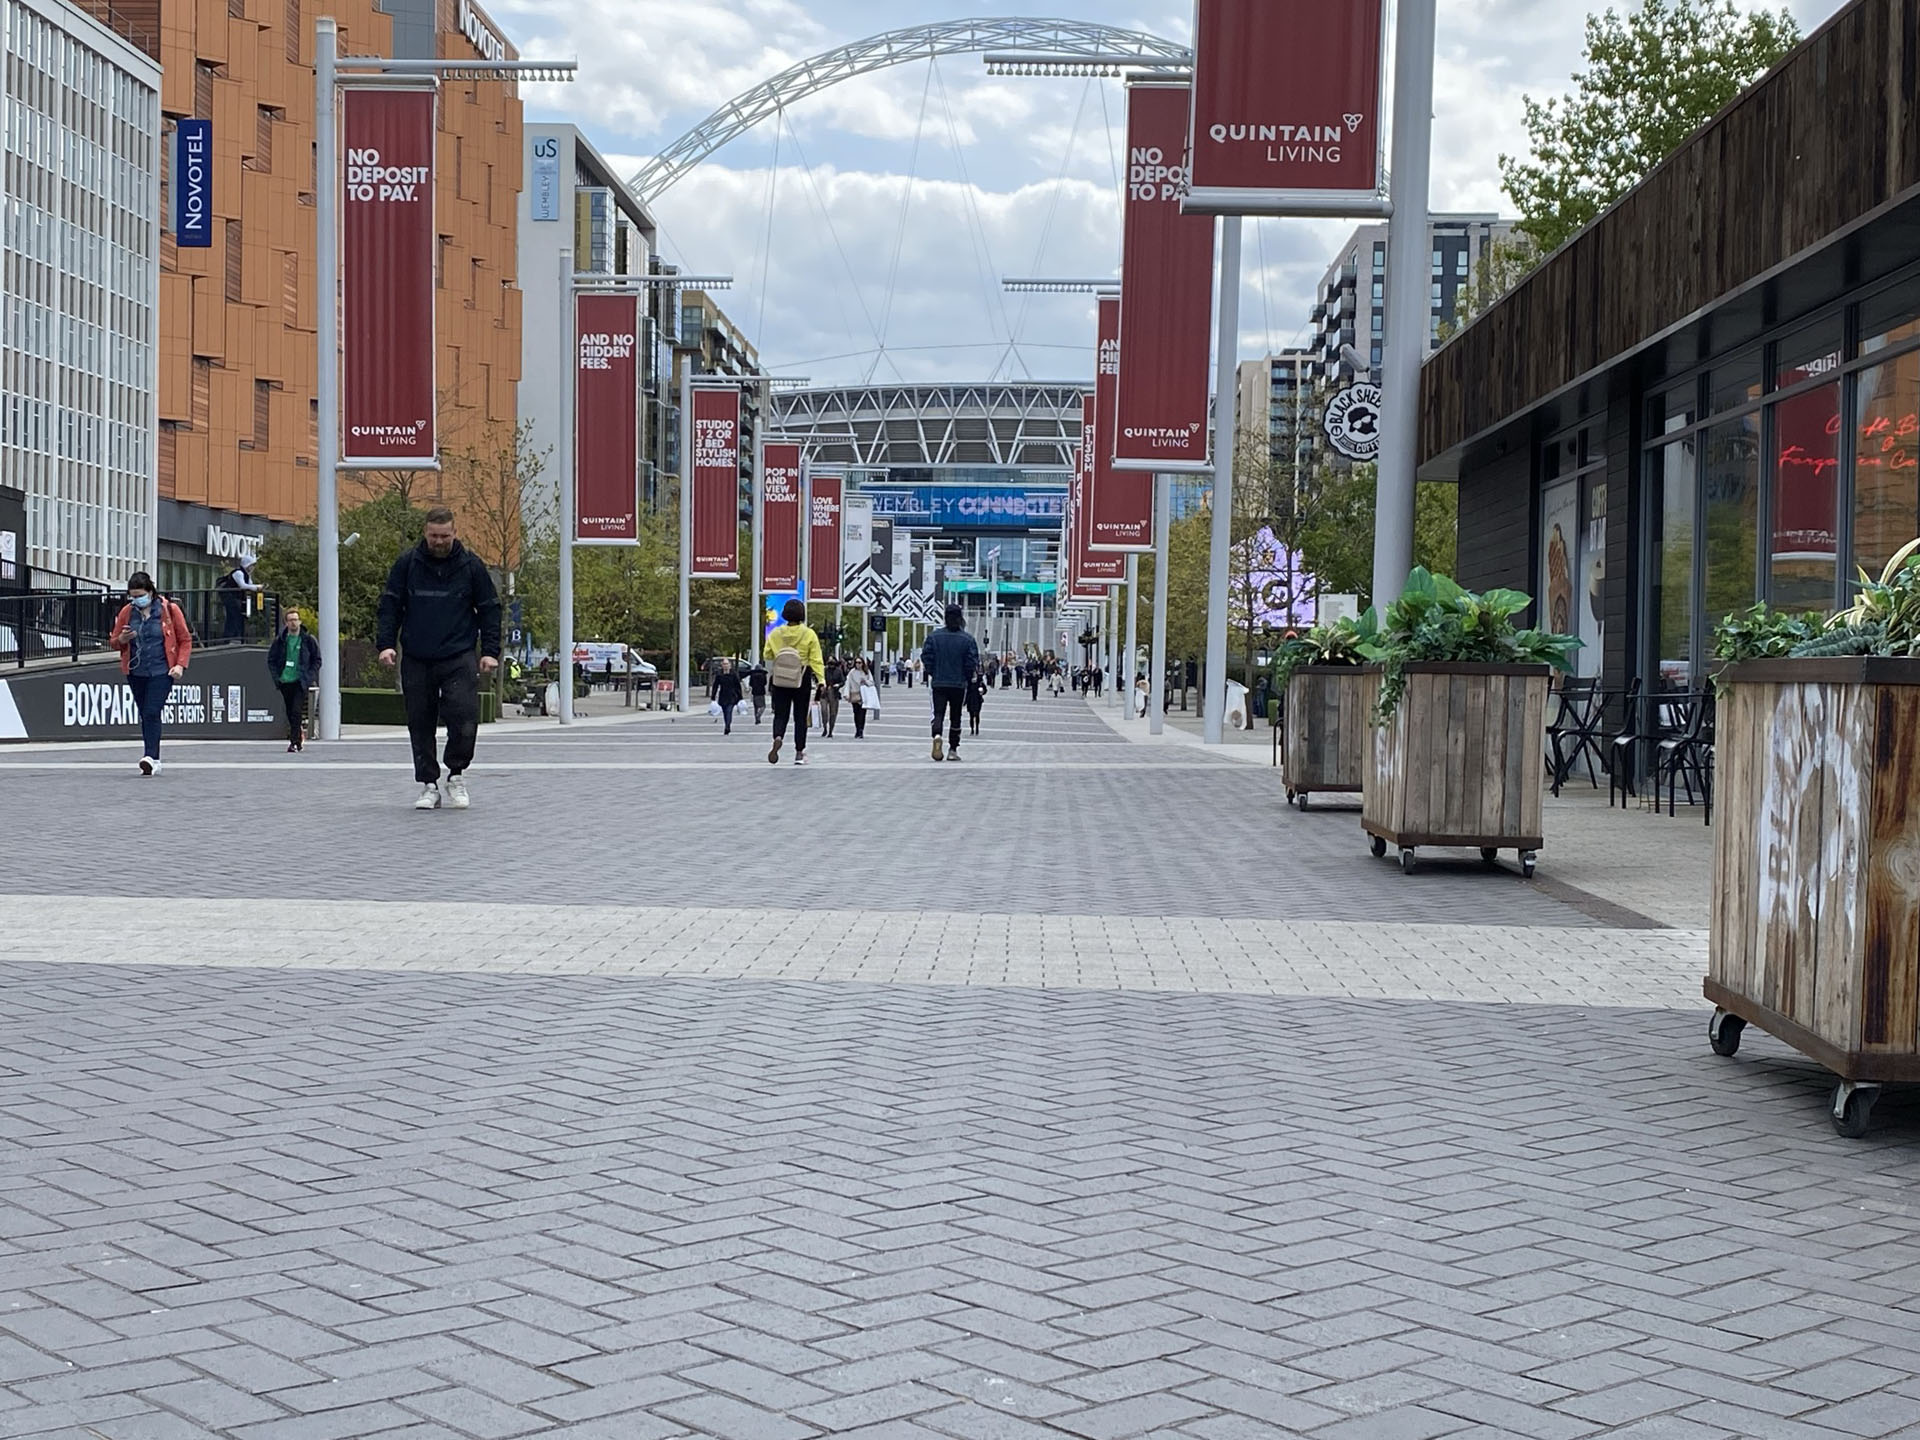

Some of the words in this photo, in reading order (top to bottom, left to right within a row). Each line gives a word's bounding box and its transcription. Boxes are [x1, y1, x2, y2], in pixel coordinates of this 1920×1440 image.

[1209, 124, 1342, 143] QUINTAIN
[348, 148, 380, 166] NO
[1131, 147, 1163, 165] NO
[1266, 145, 1342, 162] LIVING
[185, 127, 203, 229] NOVOTEL
[348, 166, 429, 184] DEPOSIT
[347, 184, 374, 201] TO
[380, 184, 418, 201] PAY.
[1129, 183, 1156, 201] TO
[580, 333, 610, 346] AND
[613, 334, 634, 346] NO
[580, 346, 630, 358] HIDDEN
[580, 357, 612, 370] FEES.
[1329, 391, 1356, 424] BLACK
[1356, 388, 1381, 408] SHEE
[696, 419, 734, 429] STUDIO
[351, 426, 416, 437] QUINTAIN
[696, 429, 704, 440] 1,
[706, 429, 713, 439] 2
[716, 429, 732, 439] OR
[1124, 427, 1189, 438] QUINTAIN
[380, 436, 416, 445] LIVING
[695, 438, 703, 448] 3
[705, 438, 725, 448] BED
[1152, 438, 1189, 448] LIVING
[1355, 440, 1379, 453] COFF
[696, 448, 736, 458] STYLISH
[696, 457, 736, 467] HOMES.
[765, 468, 786, 477] POP
[788, 468, 798, 477] IN
[765, 476, 787, 485] AND
[765, 484, 790, 493] VIEW
[765, 493, 798, 502] TODAY.
[812, 496, 833, 505] LOVE
[812, 504, 840, 512] WHERE
[872, 497, 956, 514] WEMBLEY
[812, 511, 830, 519] YOU
[812, 519, 834, 527] RENT.
[182, 685, 201, 704] FOOD
[64, 683, 139, 726] BOXPAR
[178, 705, 205, 724] EVENTS
